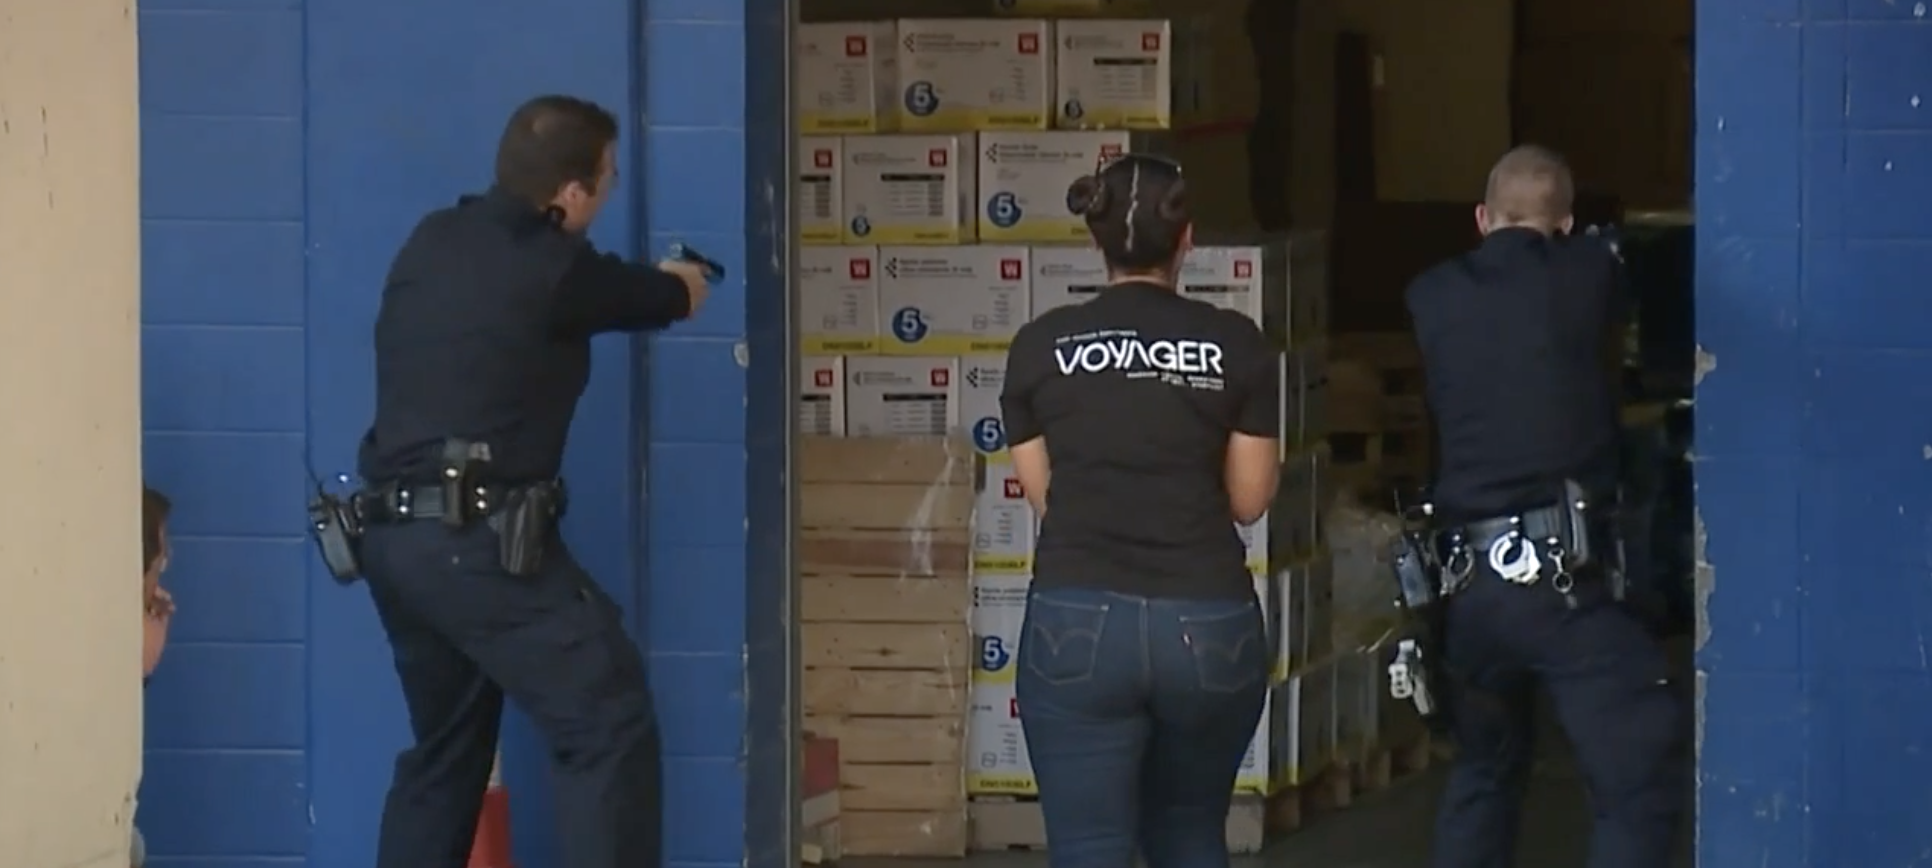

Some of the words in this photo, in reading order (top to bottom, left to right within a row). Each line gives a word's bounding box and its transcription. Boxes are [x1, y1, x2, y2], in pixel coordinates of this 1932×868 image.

[913, 84, 929, 109] 5
[996, 195, 1013, 217] 5
[900, 309, 918, 333] 5
[1054, 338, 1223, 375] VOYAGER
[981, 419, 999, 443] 5
[983, 639, 1001, 663] 5
